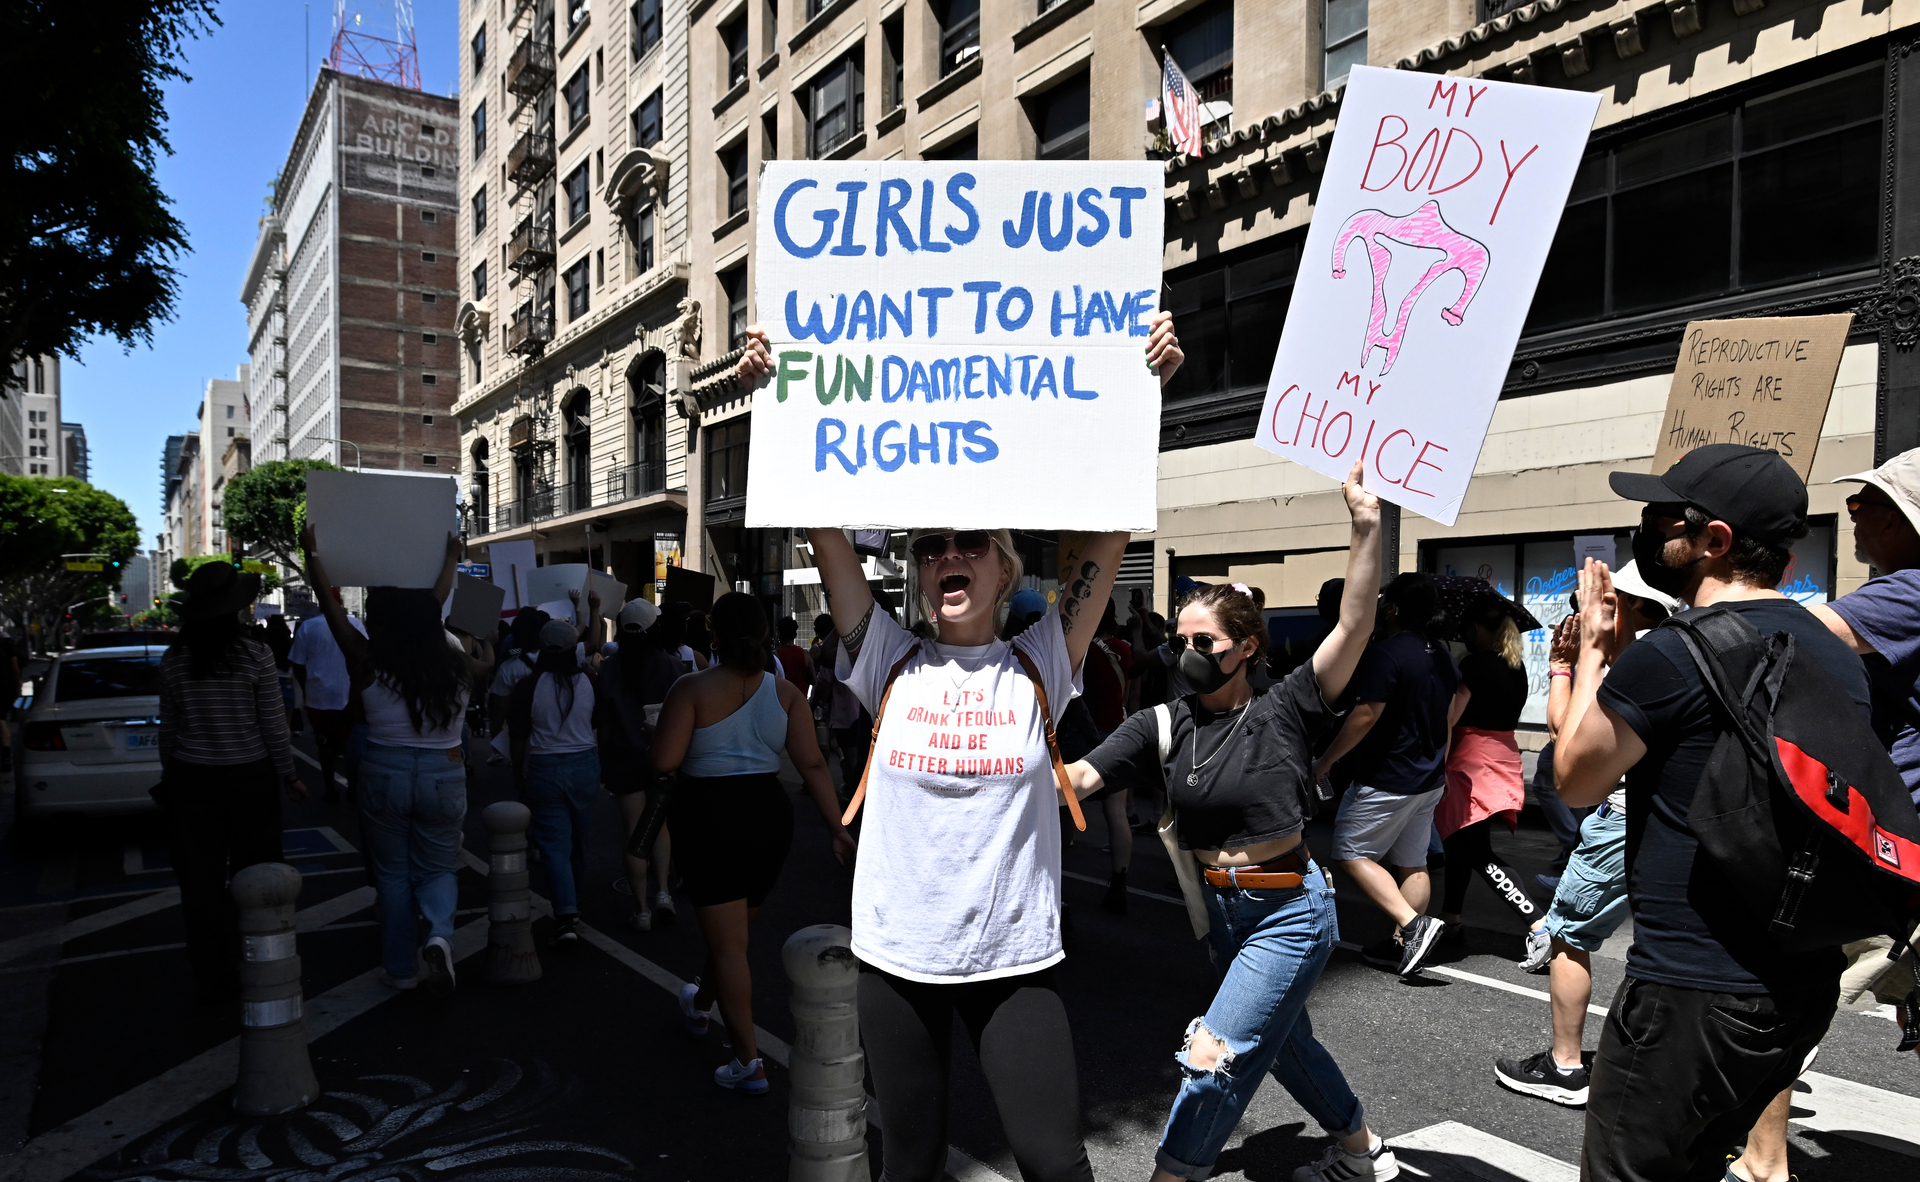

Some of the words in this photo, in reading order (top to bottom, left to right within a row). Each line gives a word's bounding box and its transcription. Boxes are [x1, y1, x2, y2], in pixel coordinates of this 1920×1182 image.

[1428, 80, 1488, 118] MY
[356, 132, 458, 173] BUILDIN
[1360, 115, 1539, 226] BODY
[773, 171, 980, 259] GIRLS
[1002, 186, 1147, 252] JUST
[784, 286, 954, 344] WANT
[962, 280, 1034, 334] TO
[1050, 284, 1156, 338] HAVE
[776, 350, 1099, 406] FUNDAMENTAL
[1336, 371, 1381, 405] MY
[1691, 372, 1742, 401] RIGHTS
[1752, 374, 1782, 402] ARE
[815, 417, 1000, 475] RIGHTS
[1271, 384, 1449, 498] CHOICE
[906, 706, 950, 727] DRINK
[956, 709, 1016, 727] TEQUILA
[943, 688, 984, 705] LT'S
[928, 732, 961, 750] AND
[968, 733, 988, 750] BE
[889, 749, 948, 775] BETTER
[955, 756, 1024, 776] HUMANS
[1485, 862, 1534, 914] adidas
